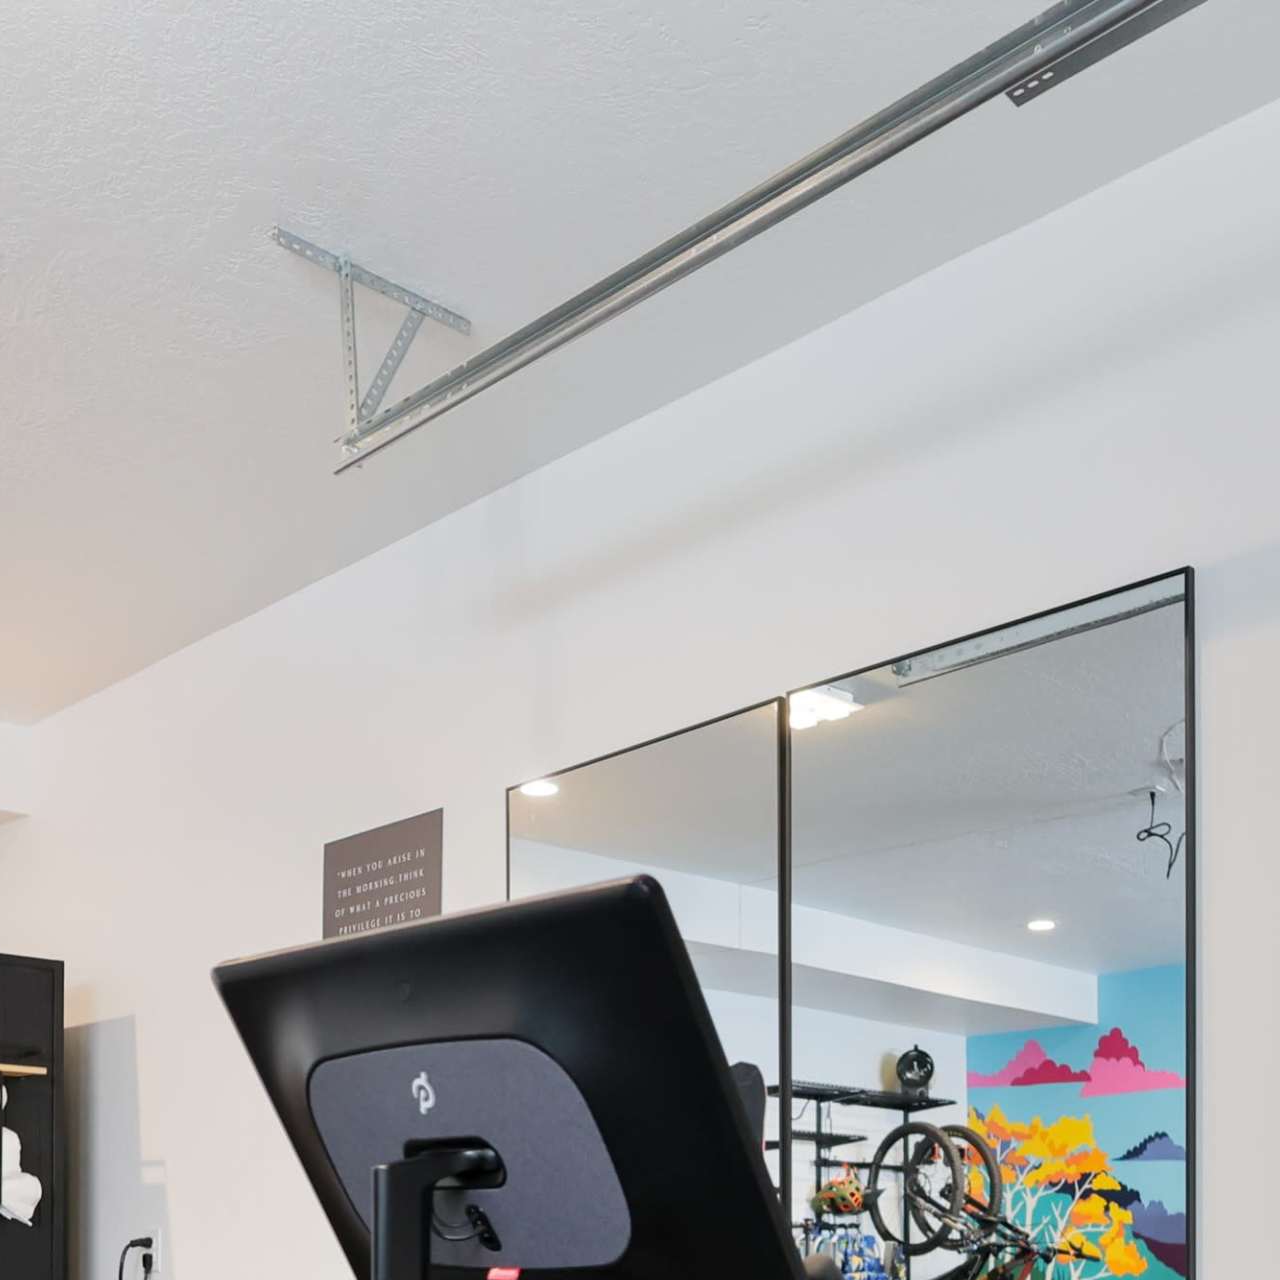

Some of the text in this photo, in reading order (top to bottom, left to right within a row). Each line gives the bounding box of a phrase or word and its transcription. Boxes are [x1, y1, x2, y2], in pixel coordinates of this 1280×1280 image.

[366, 860, 383, 873] YOU
[387, 852, 412, 867] ARISE
[415, 847, 426, 860] IN
[337, 868, 425, 899] THE MORNING THINK
[334, 887, 427, 919] OF WHAT A PRECIOUS
[338, 908, 422, 936] PRIVILEGE IT IS TO
